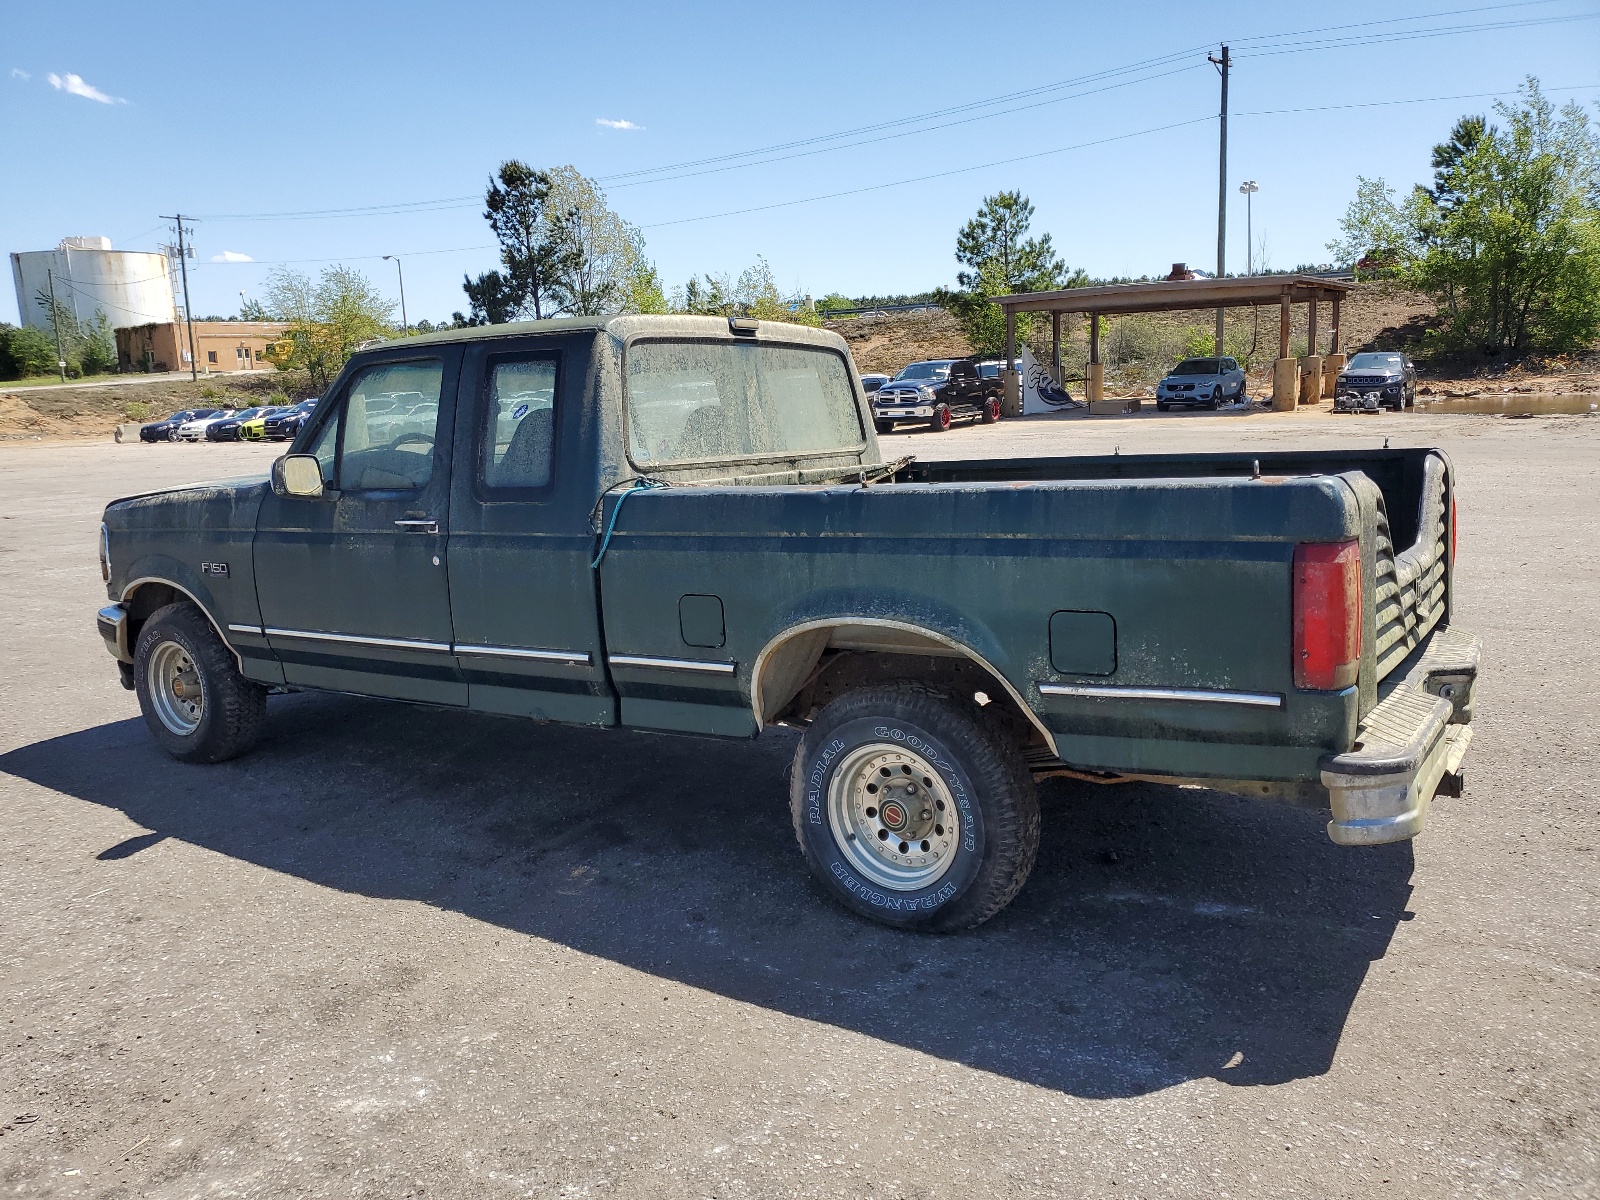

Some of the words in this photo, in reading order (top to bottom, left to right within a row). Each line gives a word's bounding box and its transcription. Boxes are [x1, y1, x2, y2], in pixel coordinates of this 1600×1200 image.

[201, 562, 228, 573] F150
[810, 739, 845, 825] RADIAL
[874, 726, 976, 852] GOODYEAR
[830, 862, 957, 911] WRANGLER
